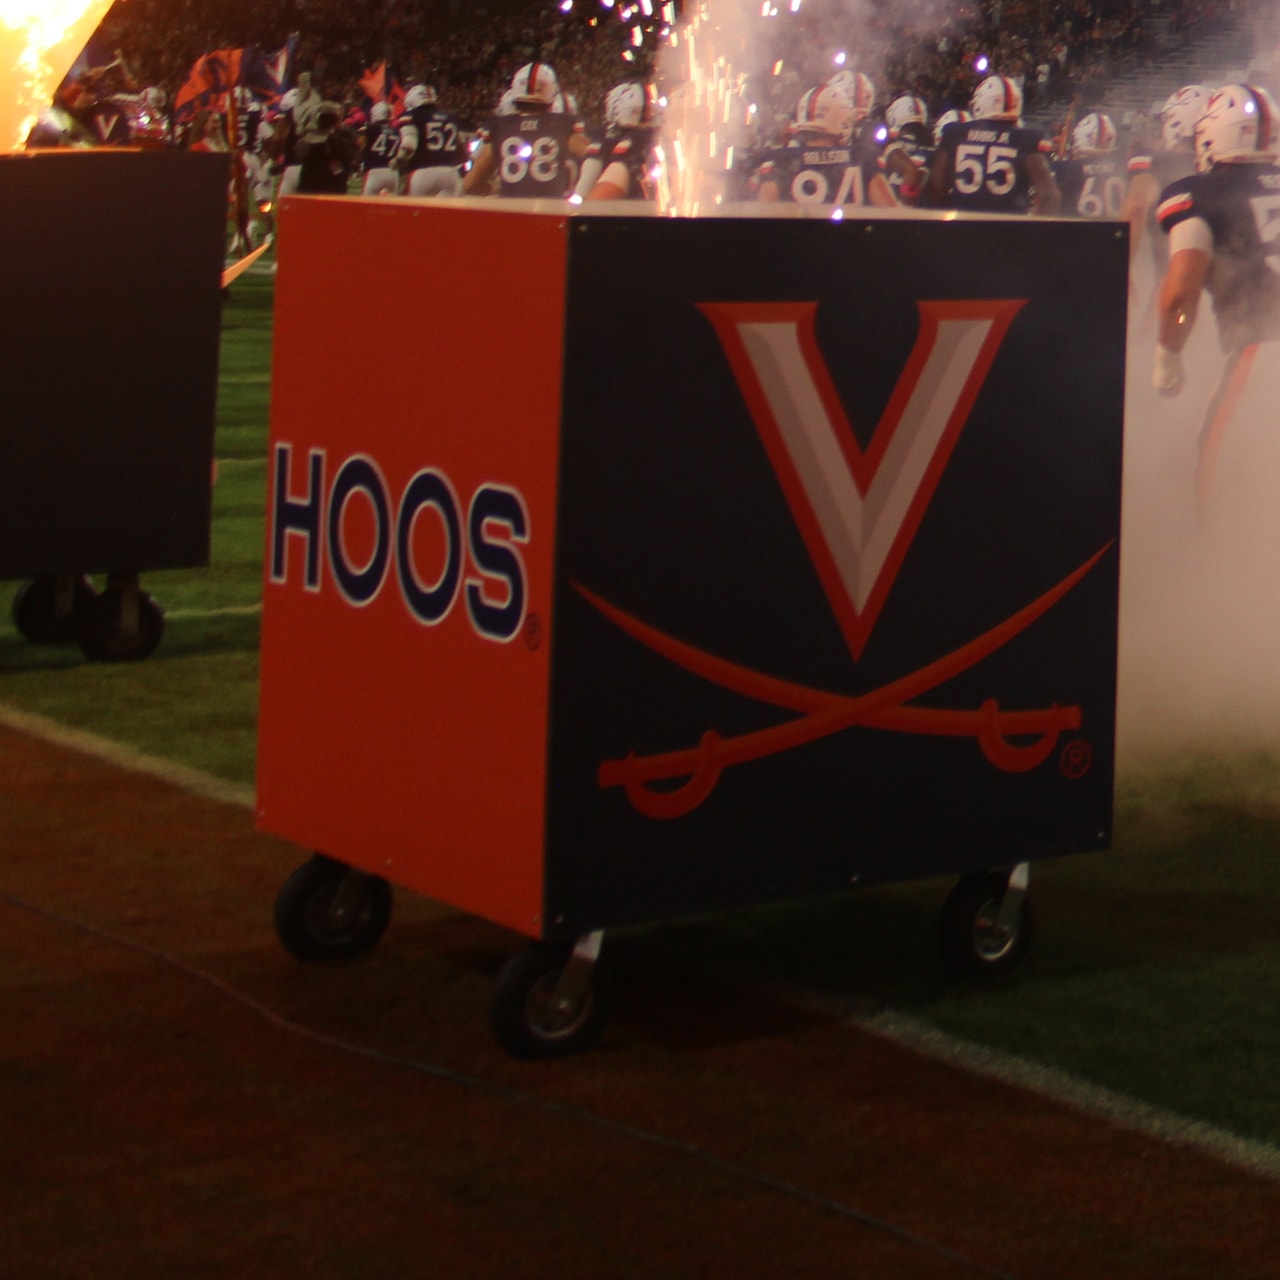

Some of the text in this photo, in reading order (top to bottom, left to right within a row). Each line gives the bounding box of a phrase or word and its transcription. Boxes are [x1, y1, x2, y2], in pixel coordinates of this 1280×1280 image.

[425, 122, 458, 151] 52
[501, 136, 559, 183] 88
[955, 144, 1018, 195] 55
[271, 442, 530, 643] HOOS
